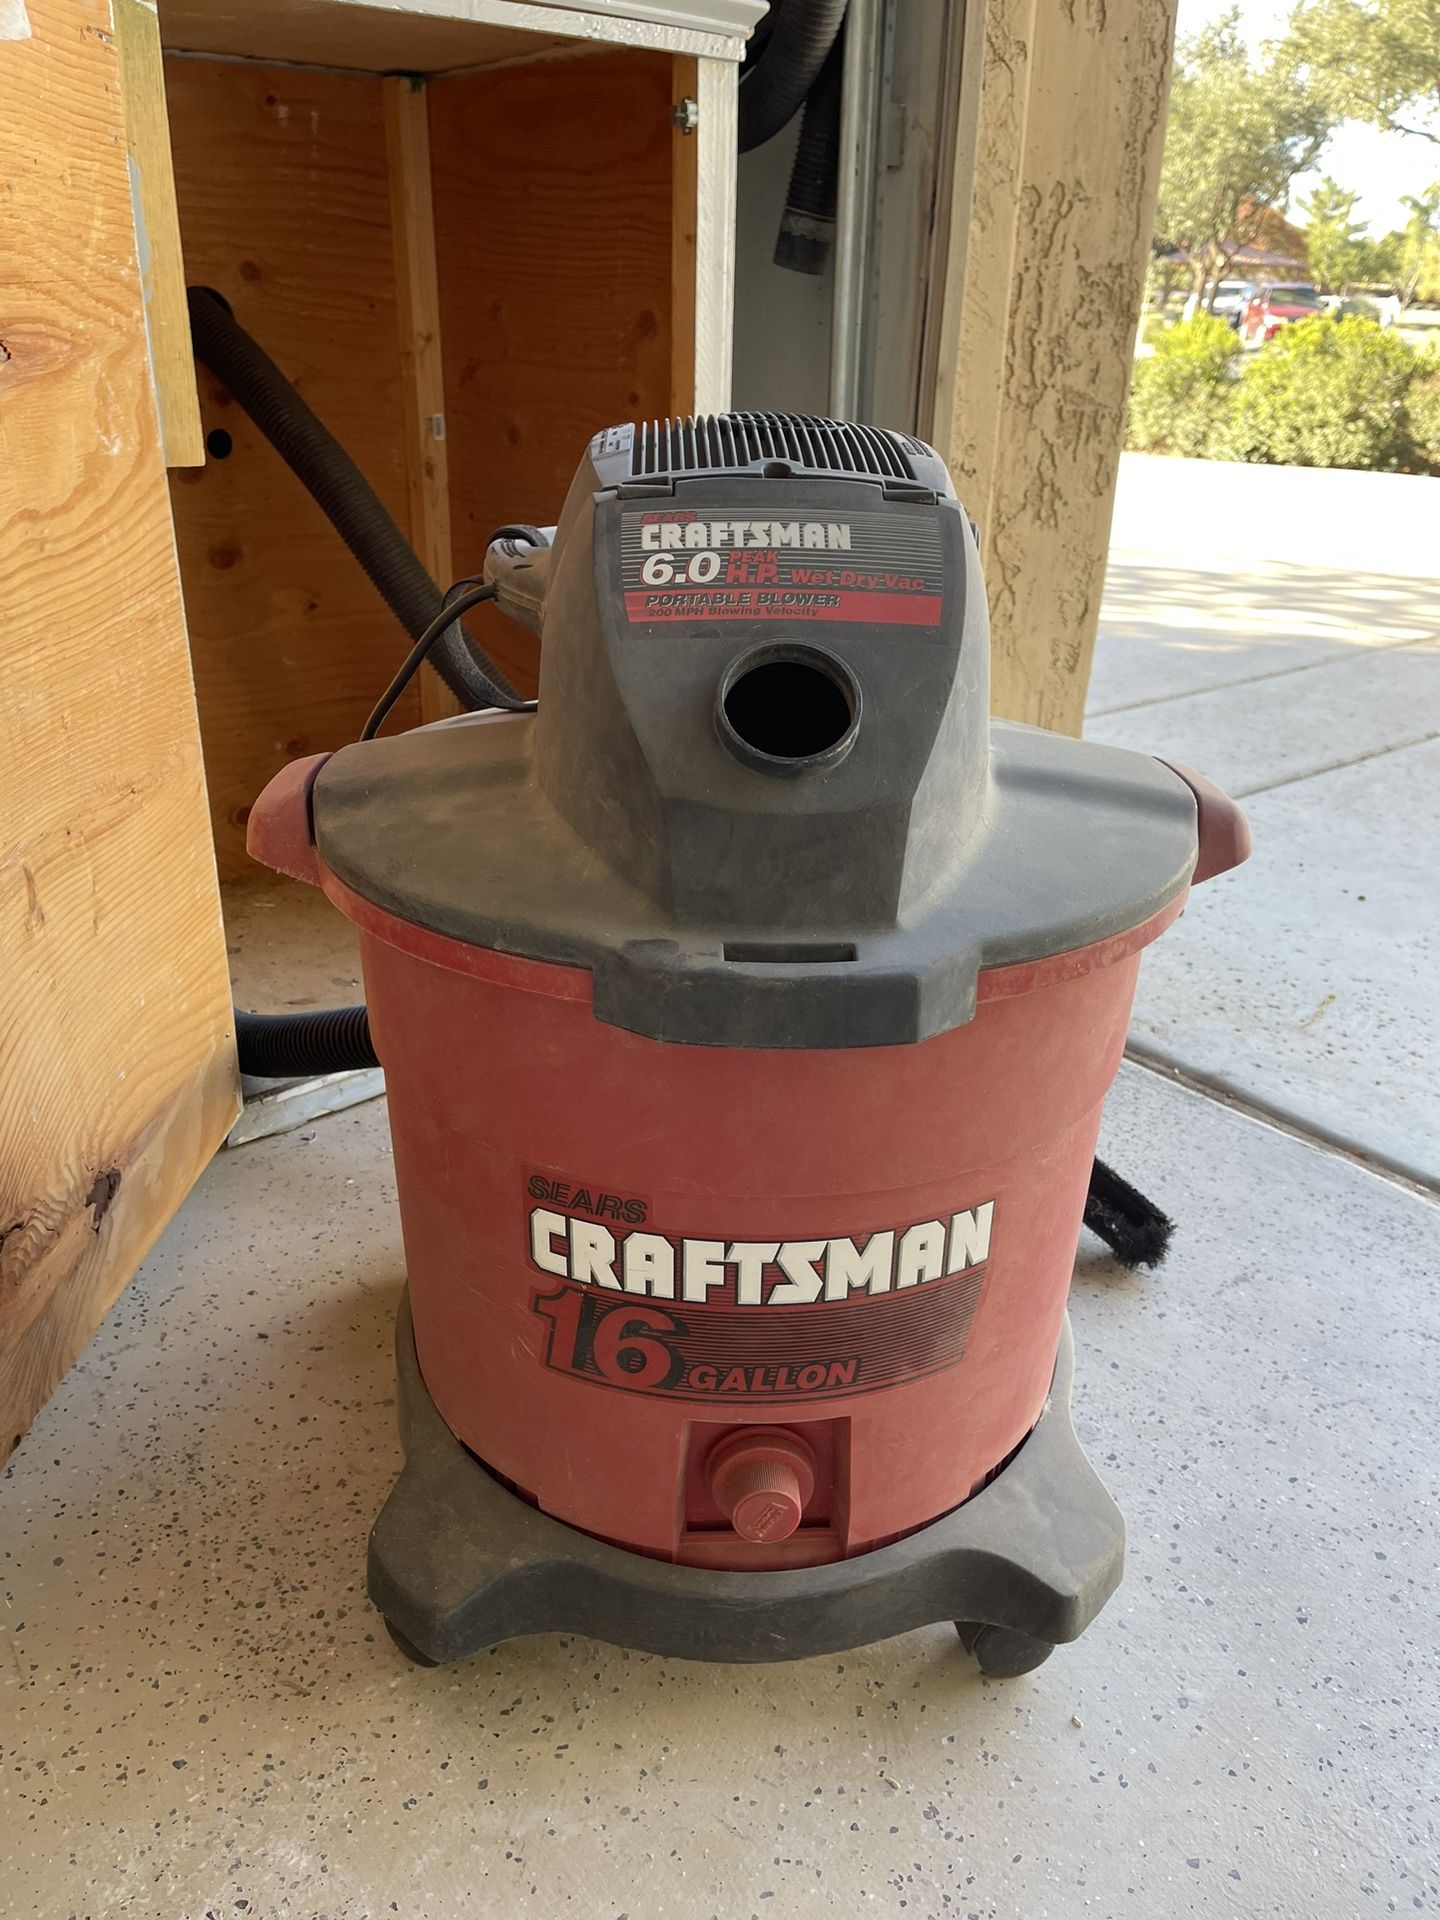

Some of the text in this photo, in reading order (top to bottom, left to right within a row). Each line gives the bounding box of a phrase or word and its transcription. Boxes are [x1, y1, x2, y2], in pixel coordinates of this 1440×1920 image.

[642, 512, 697, 523] SEARS
[641, 521, 852, 550] CRAFTSMAN
[641, 550, 779, 585] 6.0 PEAK
[725, 563, 925, 590] H.P. Wet Dry Vac
[646, 593, 841, 608] PORTABLE BLOWER
[648, 606, 818, 617] 200 MPH Blowing Velocity
[528, 1175, 648, 1224] SEARS
[530, 1200, 995, 1305] CRAFTSMAN
[535, 1287, 861, 1391] 16 GALLON
